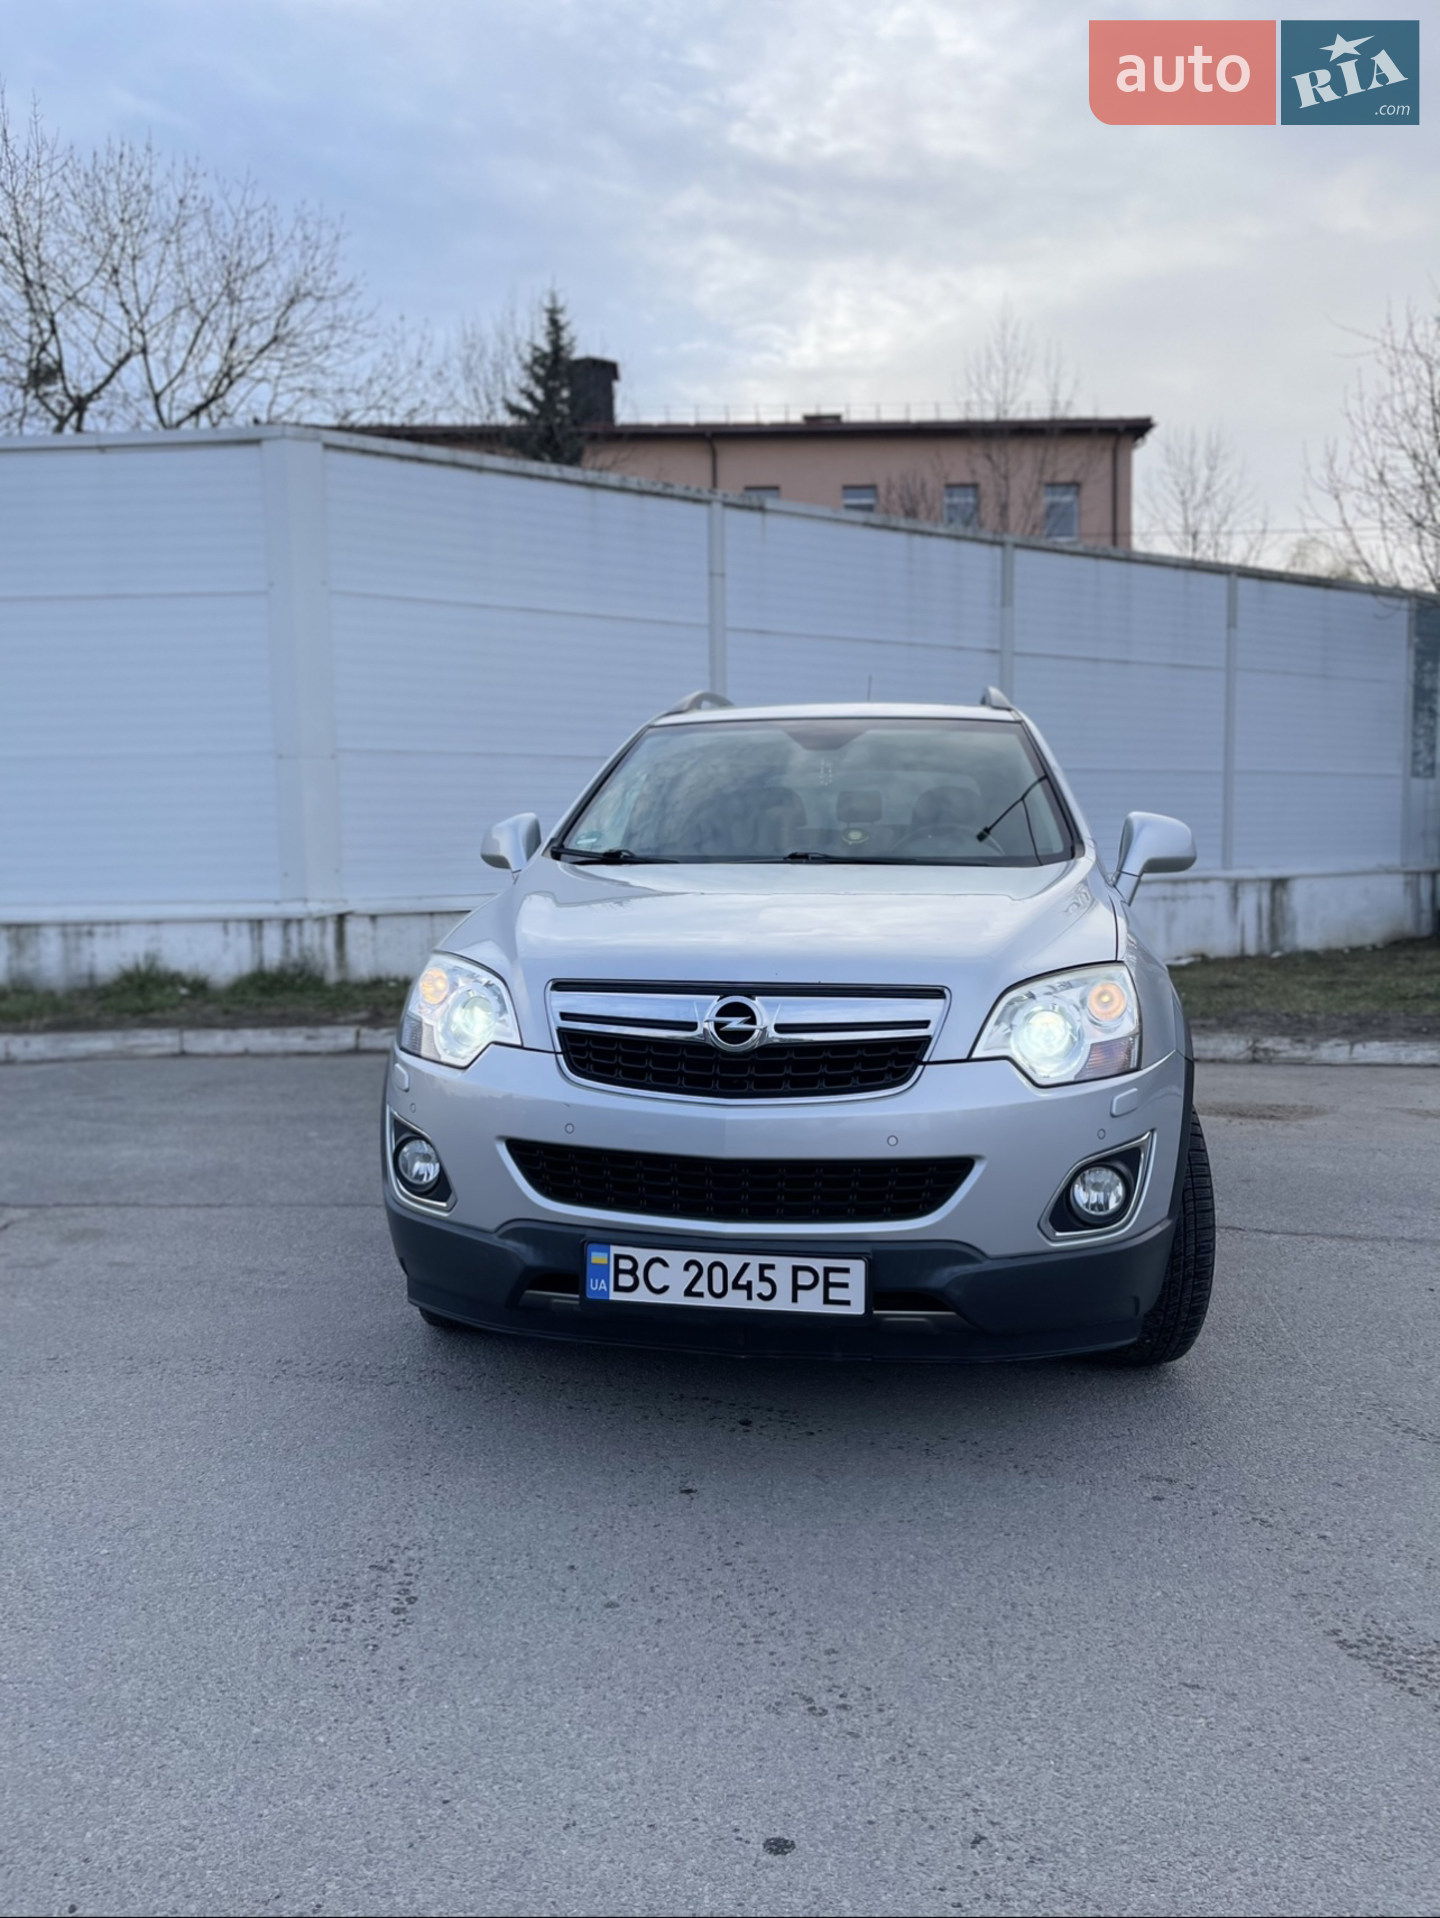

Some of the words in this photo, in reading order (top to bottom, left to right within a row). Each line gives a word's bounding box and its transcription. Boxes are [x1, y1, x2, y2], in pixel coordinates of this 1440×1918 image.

[590, 1279, 608, 1292] UA
[613, 1253, 670, 1295] BC
[682, 1258, 777, 1302] 2045
[791, 1264, 852, 1306] PE
